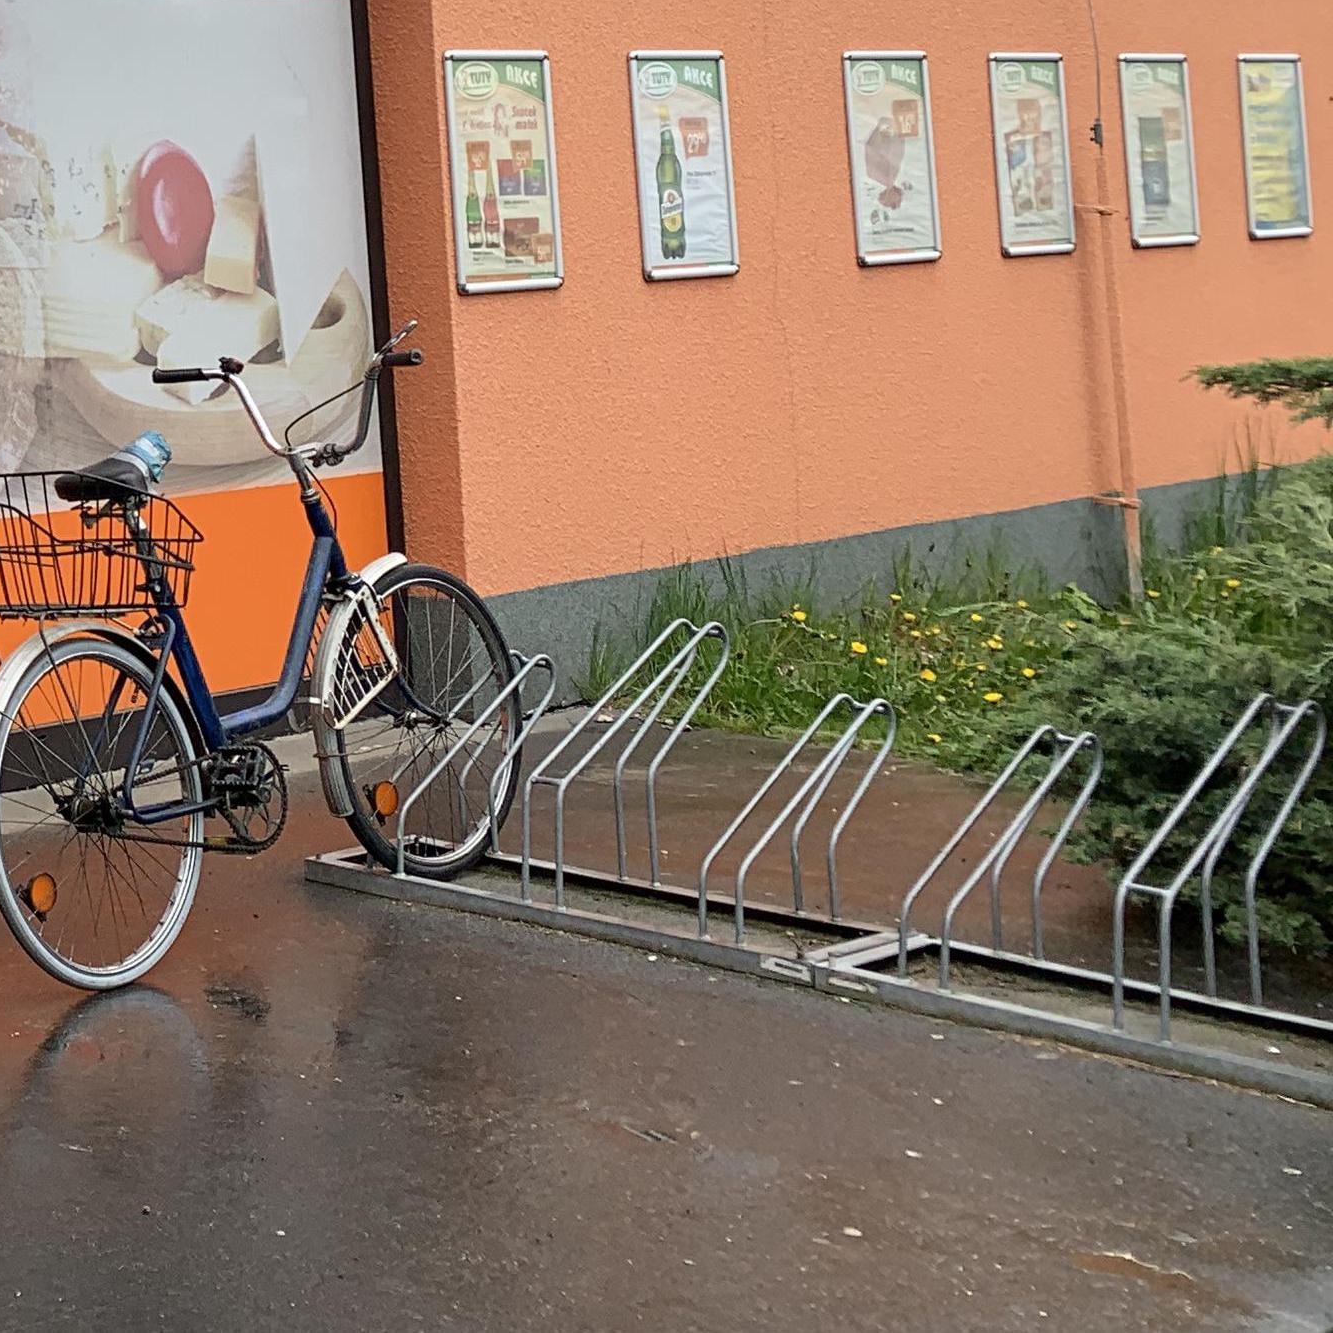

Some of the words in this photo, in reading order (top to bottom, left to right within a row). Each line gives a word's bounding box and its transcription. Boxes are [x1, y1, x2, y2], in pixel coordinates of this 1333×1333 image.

[470, 71, 491, 84] TUTY
[505, 64, 538, 89] AKCE
[684, 65, 713, 88] AKCE
